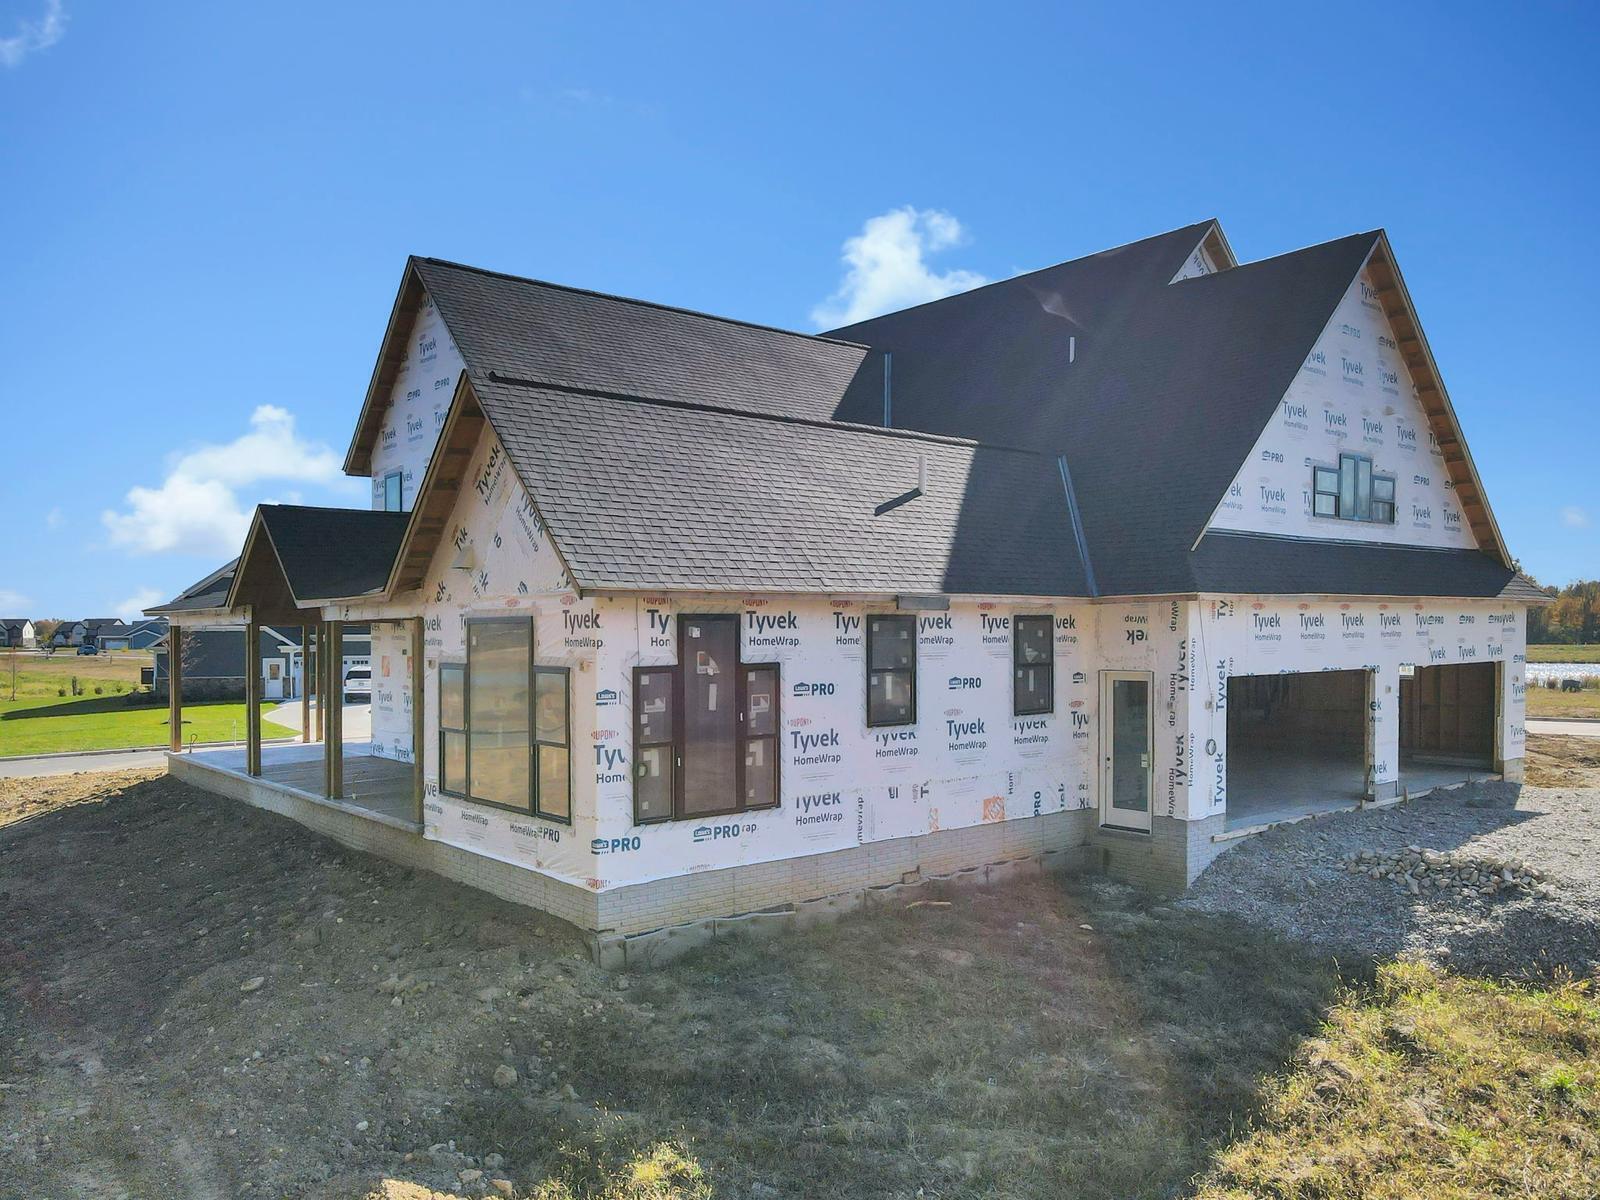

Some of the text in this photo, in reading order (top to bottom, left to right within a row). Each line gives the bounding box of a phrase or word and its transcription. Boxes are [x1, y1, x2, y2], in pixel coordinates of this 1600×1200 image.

[1342, 358, 1363, 375] Tyvek
[1283, 401, 1307, 418] Tyvek
[1324, 410, 1347, 427] Tyvek
[1362, 418, 1383, 434] Tyvek
[1397, 426, 1416, 441] Tyvek
[1271, 452, 1284, 463] PRO
[476, 443, 501, 495] Tyvek
[1260, 486, 1285, 503] Tyvek
[1412, 505, 1431, 519] Tyvek
[1443, 509, 1461, 523] Tyvek
[562, 608, 601, 635] Tyvek
[746, 610, 798, 634] Tyvek
[980, 613, 1009, 633] Tyve
[1253, 613, 1281, 632] Tyvek
[1300, 613, 1325, 631] Tyvek
[1341, 613, 1364, 630] Tyvek
[1379, 613, 1401, 630] Tyvek
[564, 637, 604, 650] HomeWrap
[749, 636, 800, 647] HomeWrap
[836, 636, 861, 645] Home
[1254, 633, 1282, 642] HomeWrap
[1458, 645, 1476, 661] Tyvek
[811, 682, 835, 696] PRO
[962, 677, 982, 689] PRO
[1216, 658, 1227, 712] Tyvek
[946, 717, 985, 740] Tyvek
[791, 728, 840, 753] Tyvek
[948, 740, 987, 751] HomeWrap
[1014, 735, 1049, 745] HomeWrap
[793, 754, 841, 766] HomeWrap
[875, 746, 918, 758] HomeWrap
[1214, 752, 1225, 806] Tyvek
[461, 810, 489, 826] HomeWrap
[796, 812, 843, 826] HomeWrap
[543, 827, 560, 843] PRO
[713, 824, 740, 840] PRO
[611, 836, 641, 853] PRO
